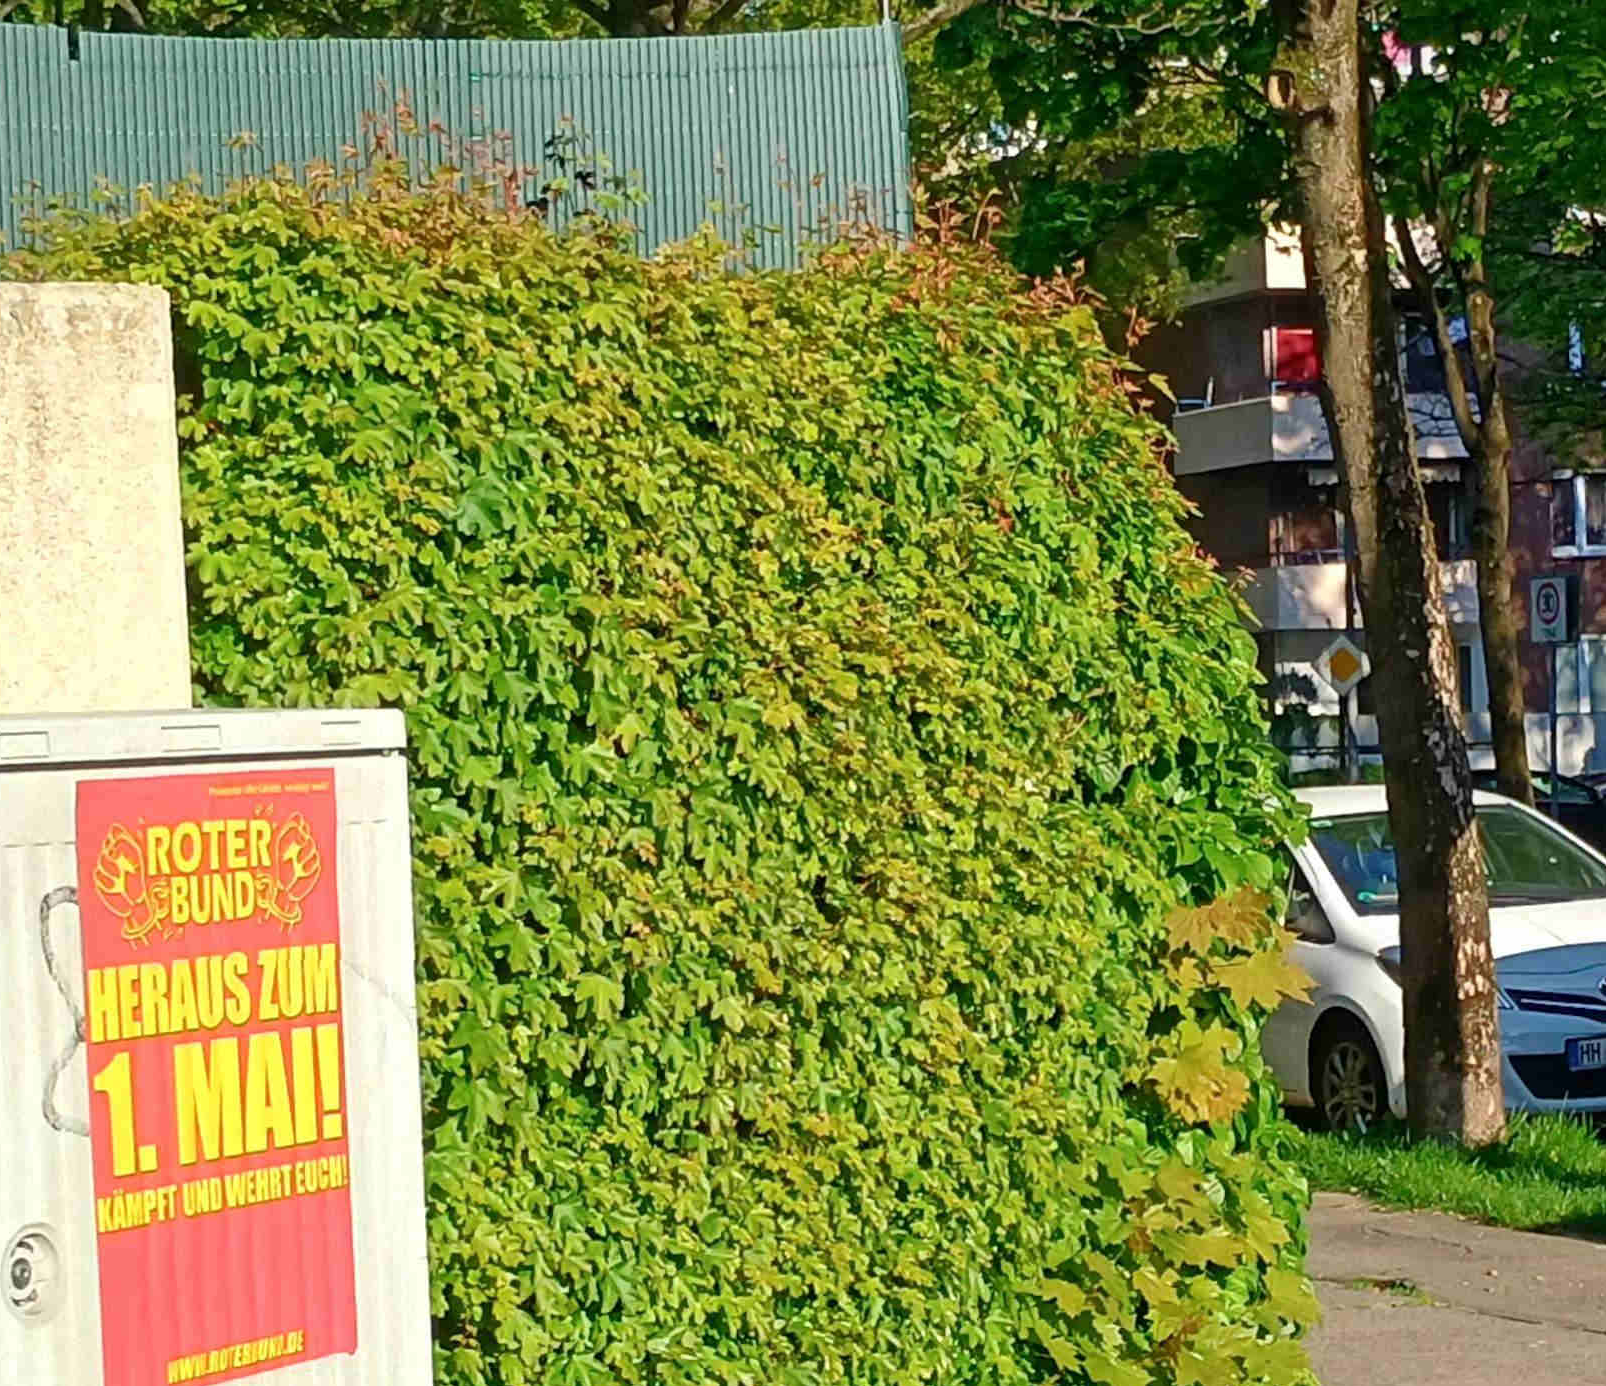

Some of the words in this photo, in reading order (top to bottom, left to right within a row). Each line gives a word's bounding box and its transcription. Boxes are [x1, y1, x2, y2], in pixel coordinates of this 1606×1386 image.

[145, 819, 272, 877] ROTER
[170, 873, 256, 926] BUND
[88, 950, 251, 1043] HERAUS
[257, 943, 338, 1019] ZUM
[1580, 1042, 1601, 1064] HH
[94, 1051, 159, 1177] 1.
[173, 1023, 343, 1166] MAI!
[97, 1185, 178, 1233] KÄMPFT
[182, 1177, 223, 1216] UND
[225, 1164, 293, 1208] WEHRT
[295, 1155, 348, 1195] EUCH!
